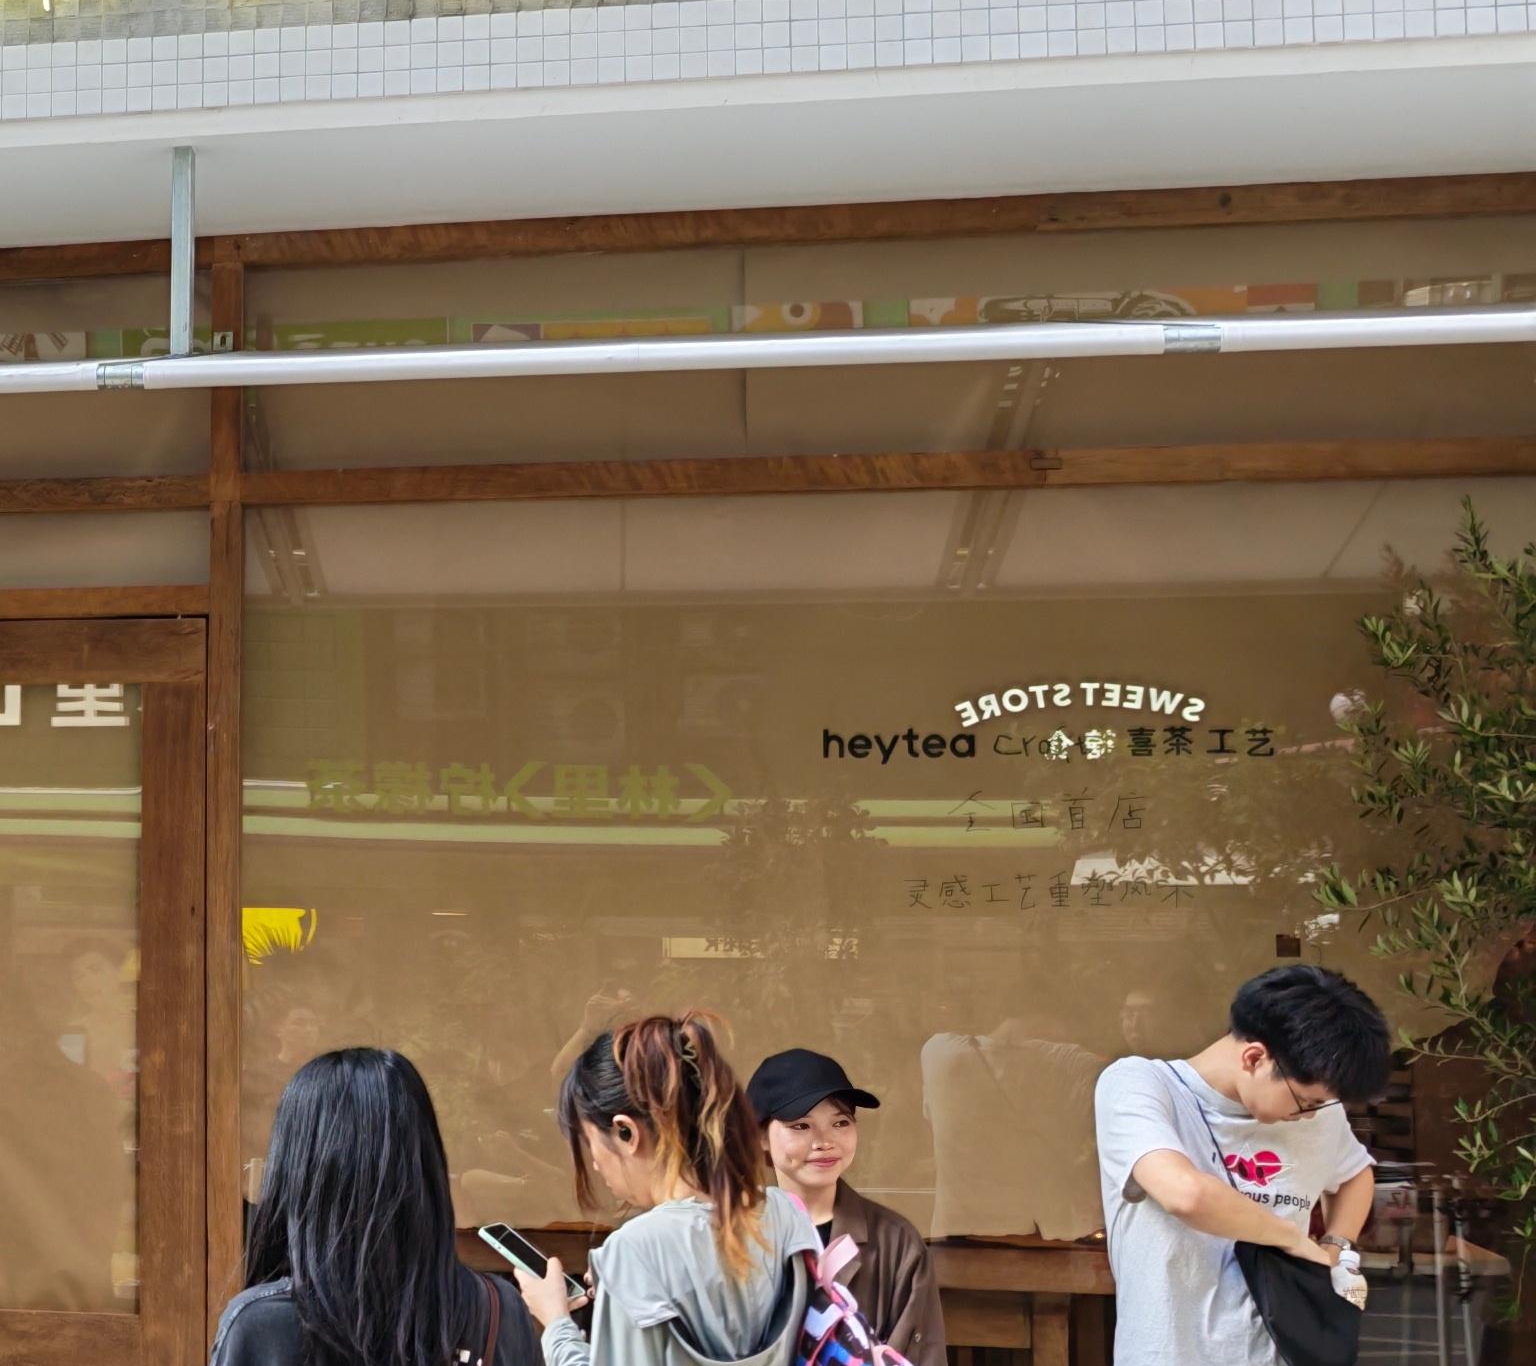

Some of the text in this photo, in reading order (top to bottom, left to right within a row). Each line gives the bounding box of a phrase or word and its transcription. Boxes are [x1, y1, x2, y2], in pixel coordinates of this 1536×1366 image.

[822, 728, 977, 765] heytea
[948, 788, 1150, 833] 全国首店
